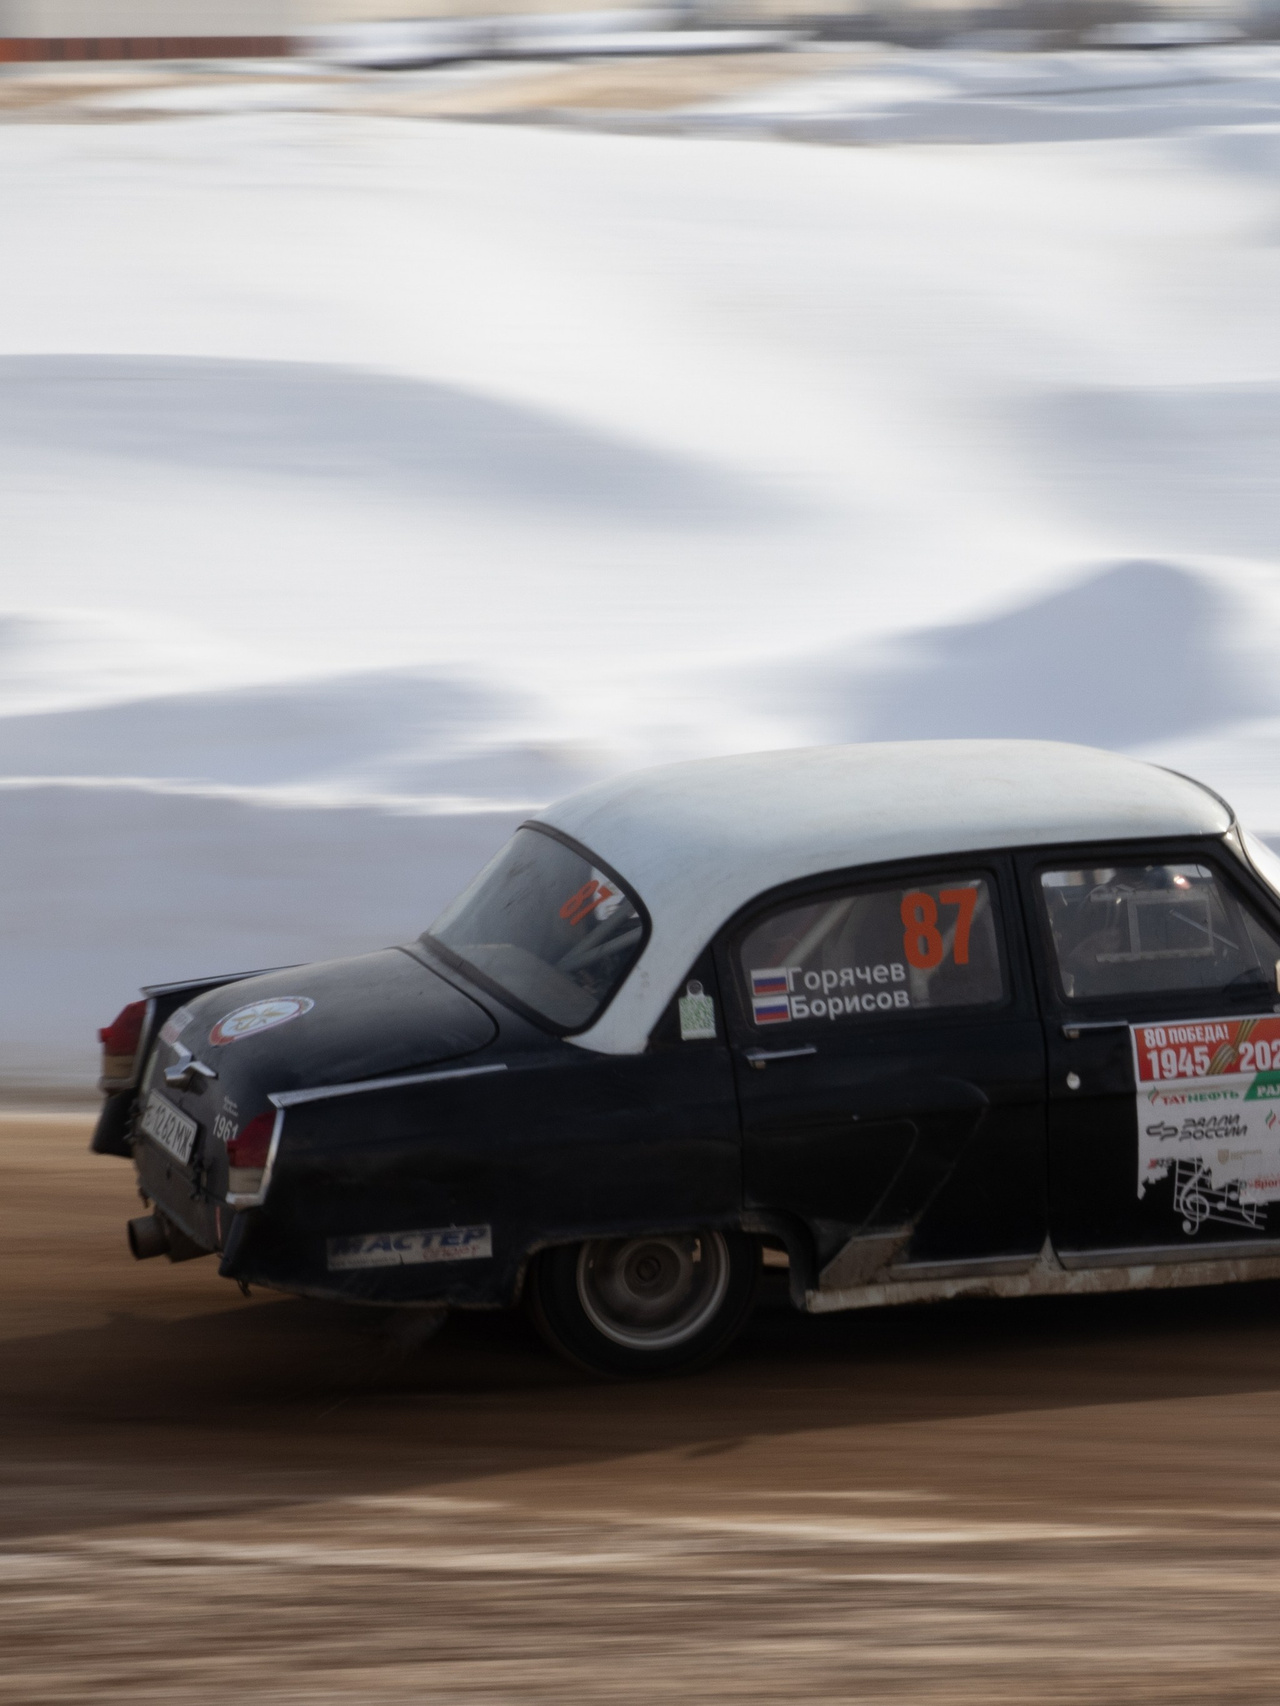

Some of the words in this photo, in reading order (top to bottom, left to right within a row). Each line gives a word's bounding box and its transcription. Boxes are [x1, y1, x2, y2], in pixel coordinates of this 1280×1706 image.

[559, 880, 613, 926] 87
[901, 888, 978, 970] 87
[787, 962, 906, 994] Горячев
[790, 990, 910, 1021] Борисов
[1143, 1028, 1167, 1048] 80
[1168, 1024, 1230, 1045] ПОБЕДА!
[1146, 1046, 1212, 1080] 1945
[1160, 1089, 1240, 1106] ТАТНЕФТЬ
[212, 1113, 239, 1142] 1961
